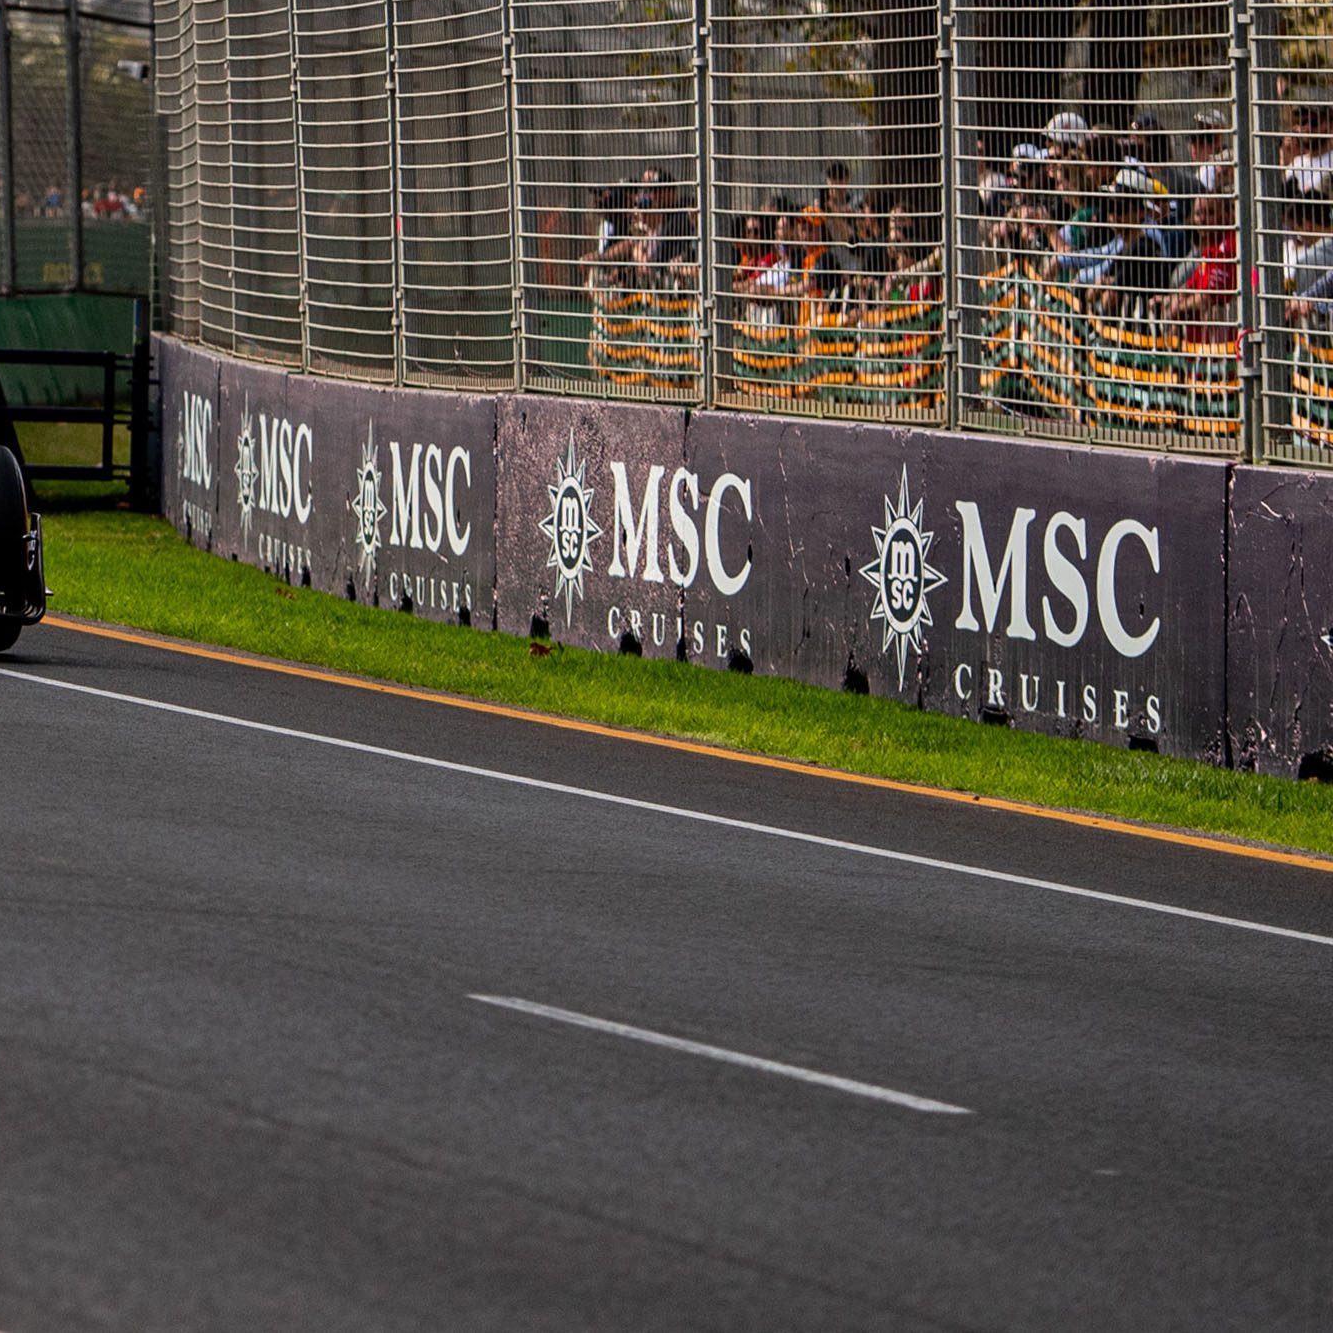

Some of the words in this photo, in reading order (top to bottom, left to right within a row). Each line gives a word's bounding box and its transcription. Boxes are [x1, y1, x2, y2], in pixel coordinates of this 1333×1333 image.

[184, 390, 213, 490] MSC
[259, 414, 313, 524] MSC
[389, 441, 472, 556] MSC
[607, 461, 753, 596] MSC
[258, 533, 312, 574] CRUISES
[389, 572, 472, 613] CRUISES
[955, 500, 1161, 657] MSC
[608, 606, 752, 658] CRUISES
[955, 664, 1161, 734] CRUISES
